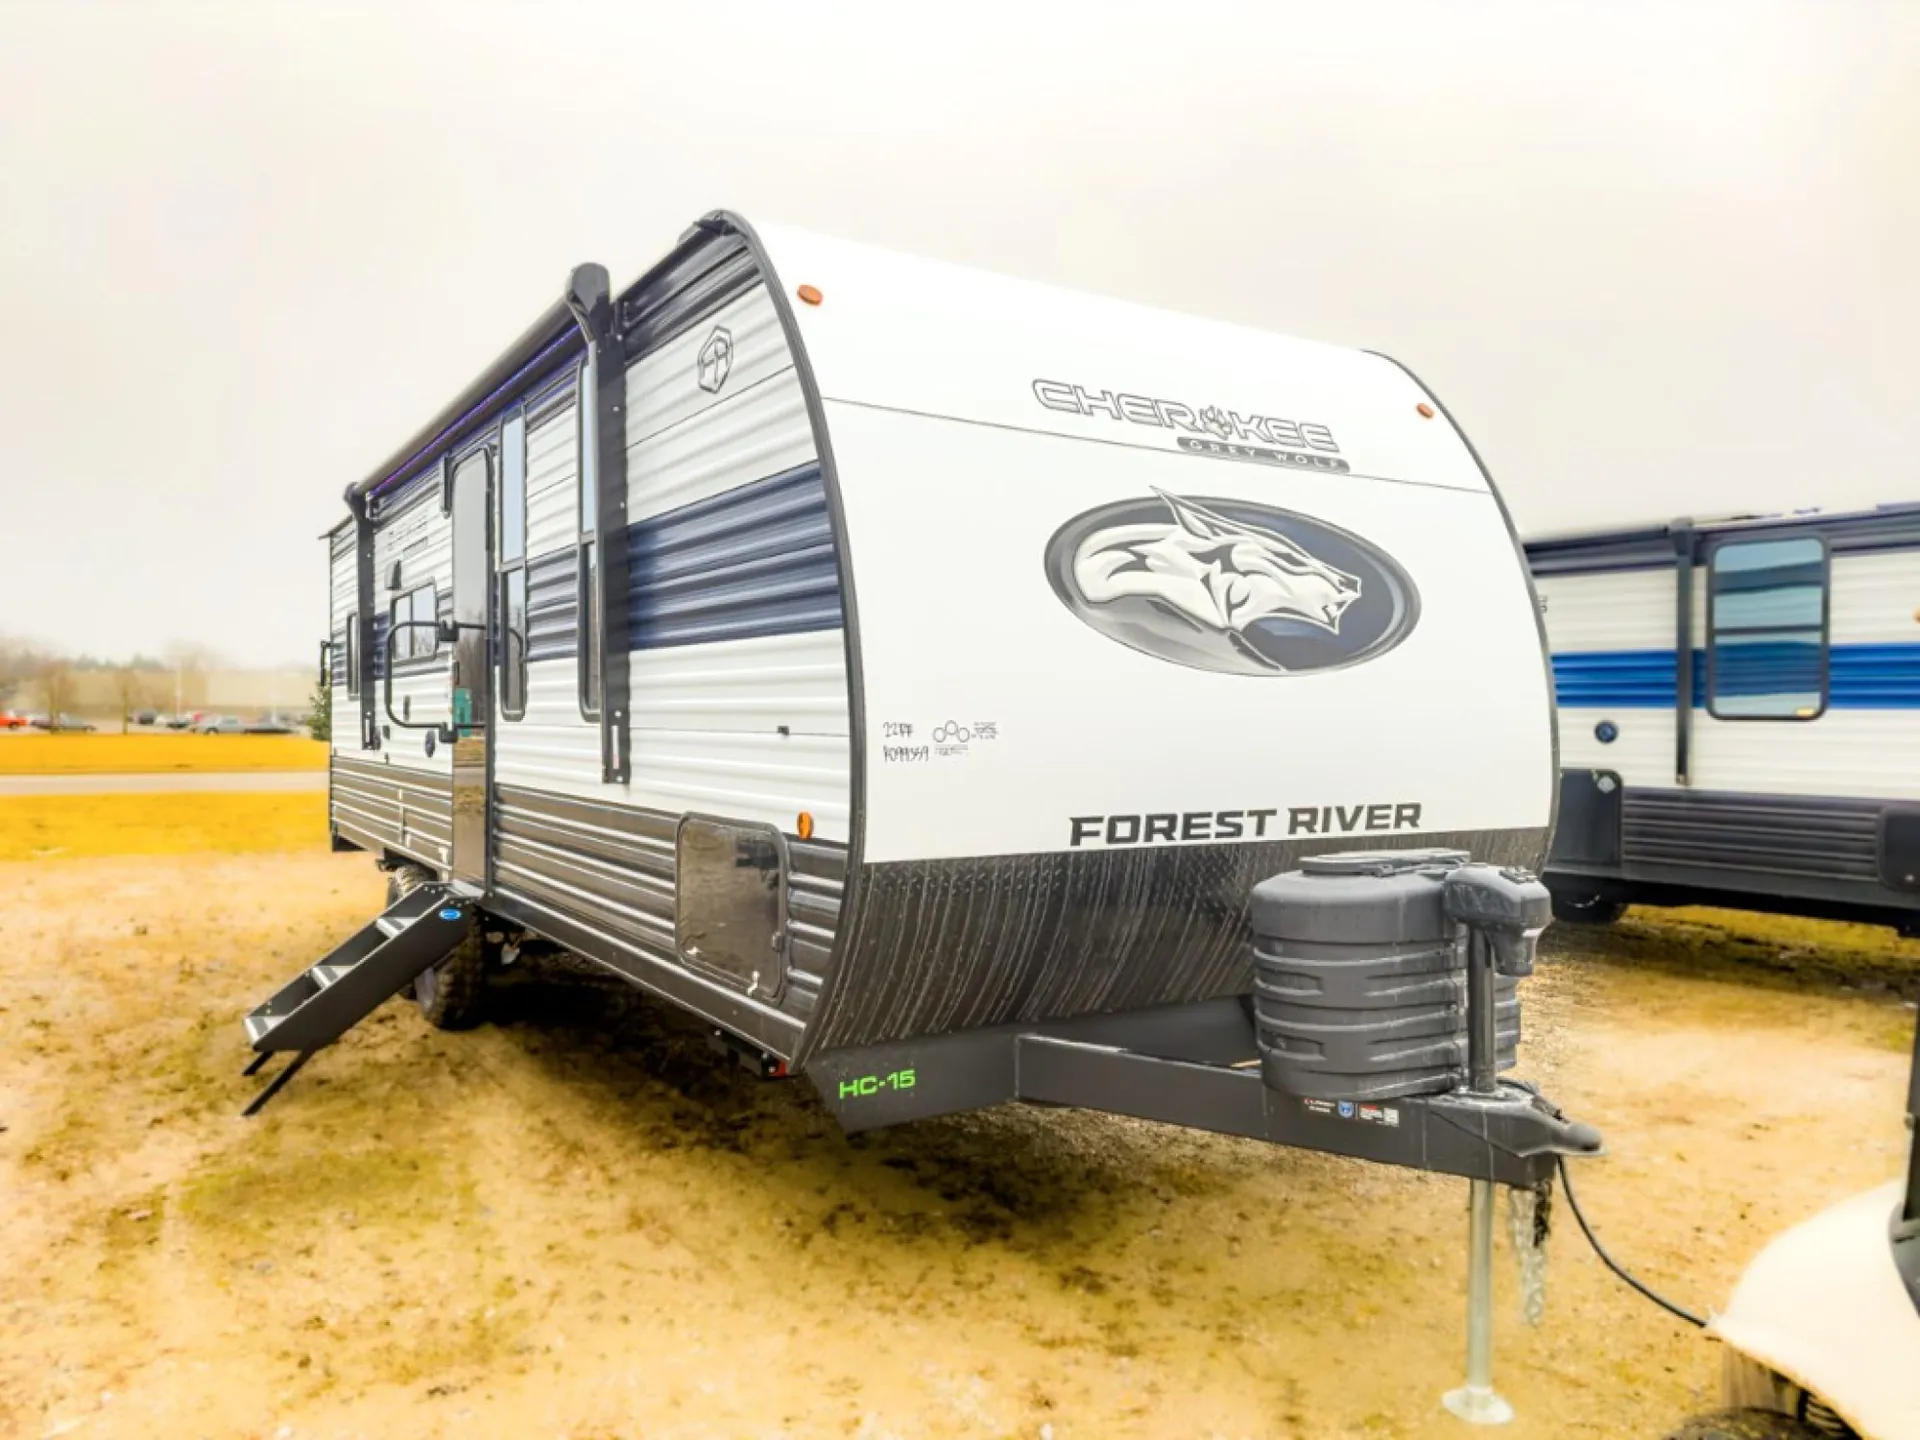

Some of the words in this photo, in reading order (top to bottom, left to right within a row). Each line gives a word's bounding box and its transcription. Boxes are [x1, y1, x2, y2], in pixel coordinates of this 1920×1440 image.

[1032, 378, 1340, 453] CHEROKEE
[1189, 438, 1256, 458] GREY
[1273, 450, 1339, 468] WOLF
[1069, 808, 1278, 847] FOREST
[1287, 801, 1423, 835] RIVER
[839, 1068, 916, 1100] HC-15
